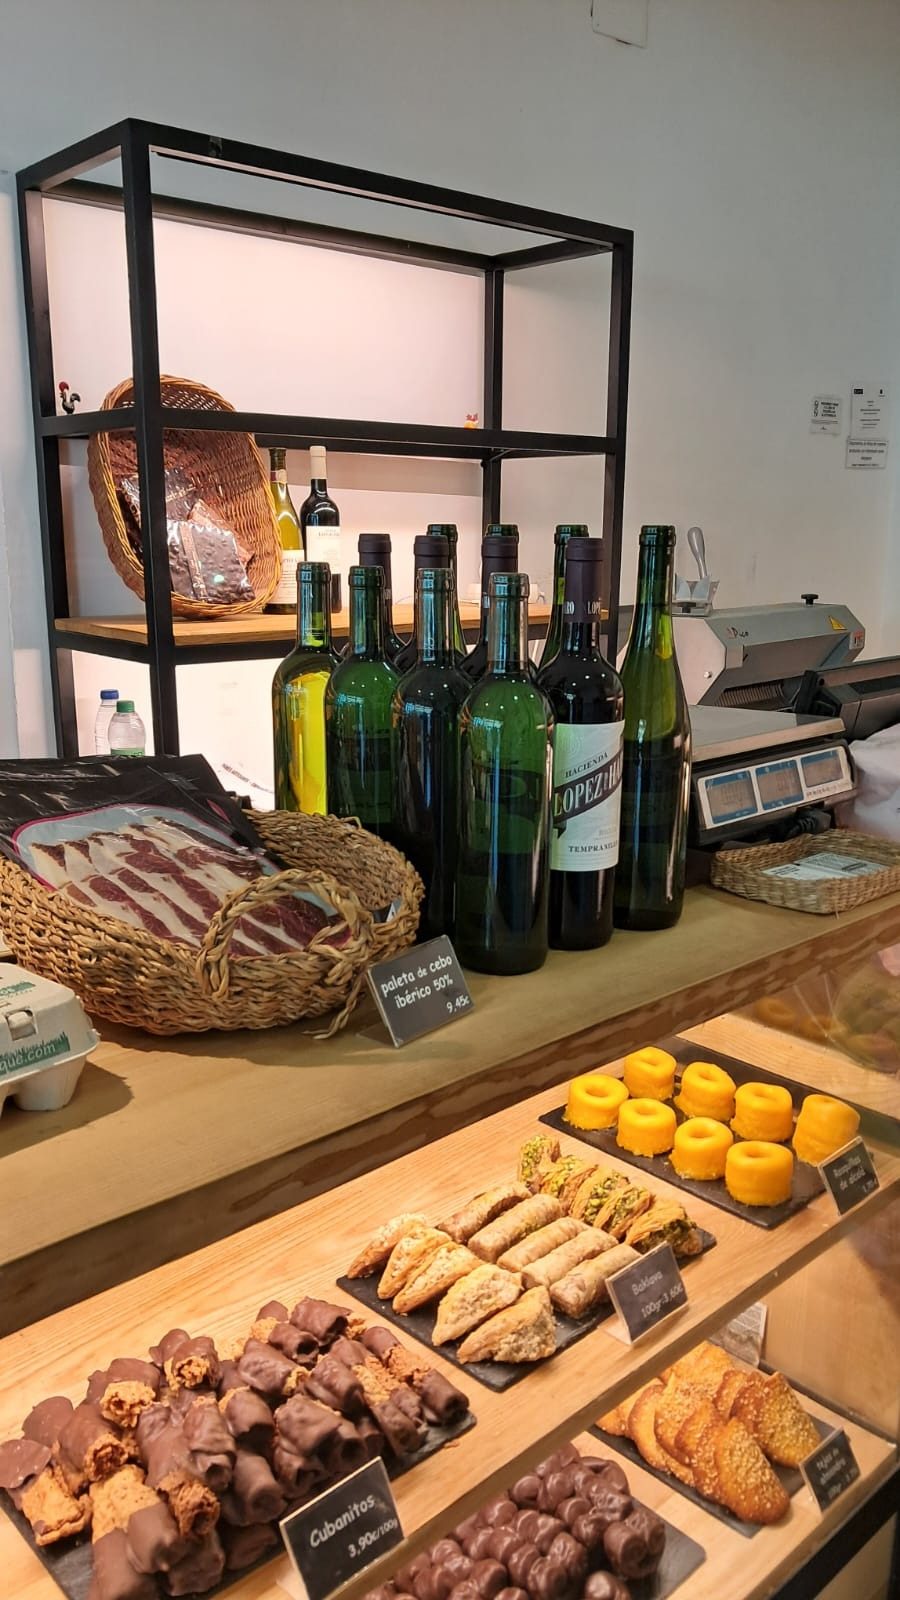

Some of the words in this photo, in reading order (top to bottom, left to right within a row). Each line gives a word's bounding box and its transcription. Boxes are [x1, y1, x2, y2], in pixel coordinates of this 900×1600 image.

[565, 752, 608, 778] HACIENDA
[554, 772, 603, 817] LOPEZ
[381, 971, 415, 998] paleta
[417, 967, 428, 978] de
[429, 955, 453, 972] cebo
[394, 985, 431, 1009] ibérico
[433, 974, 453, 991] 50%
[631, 1271, 664, 1296] Baklava
[309, 1494, 375, 1548] Cubanitos
